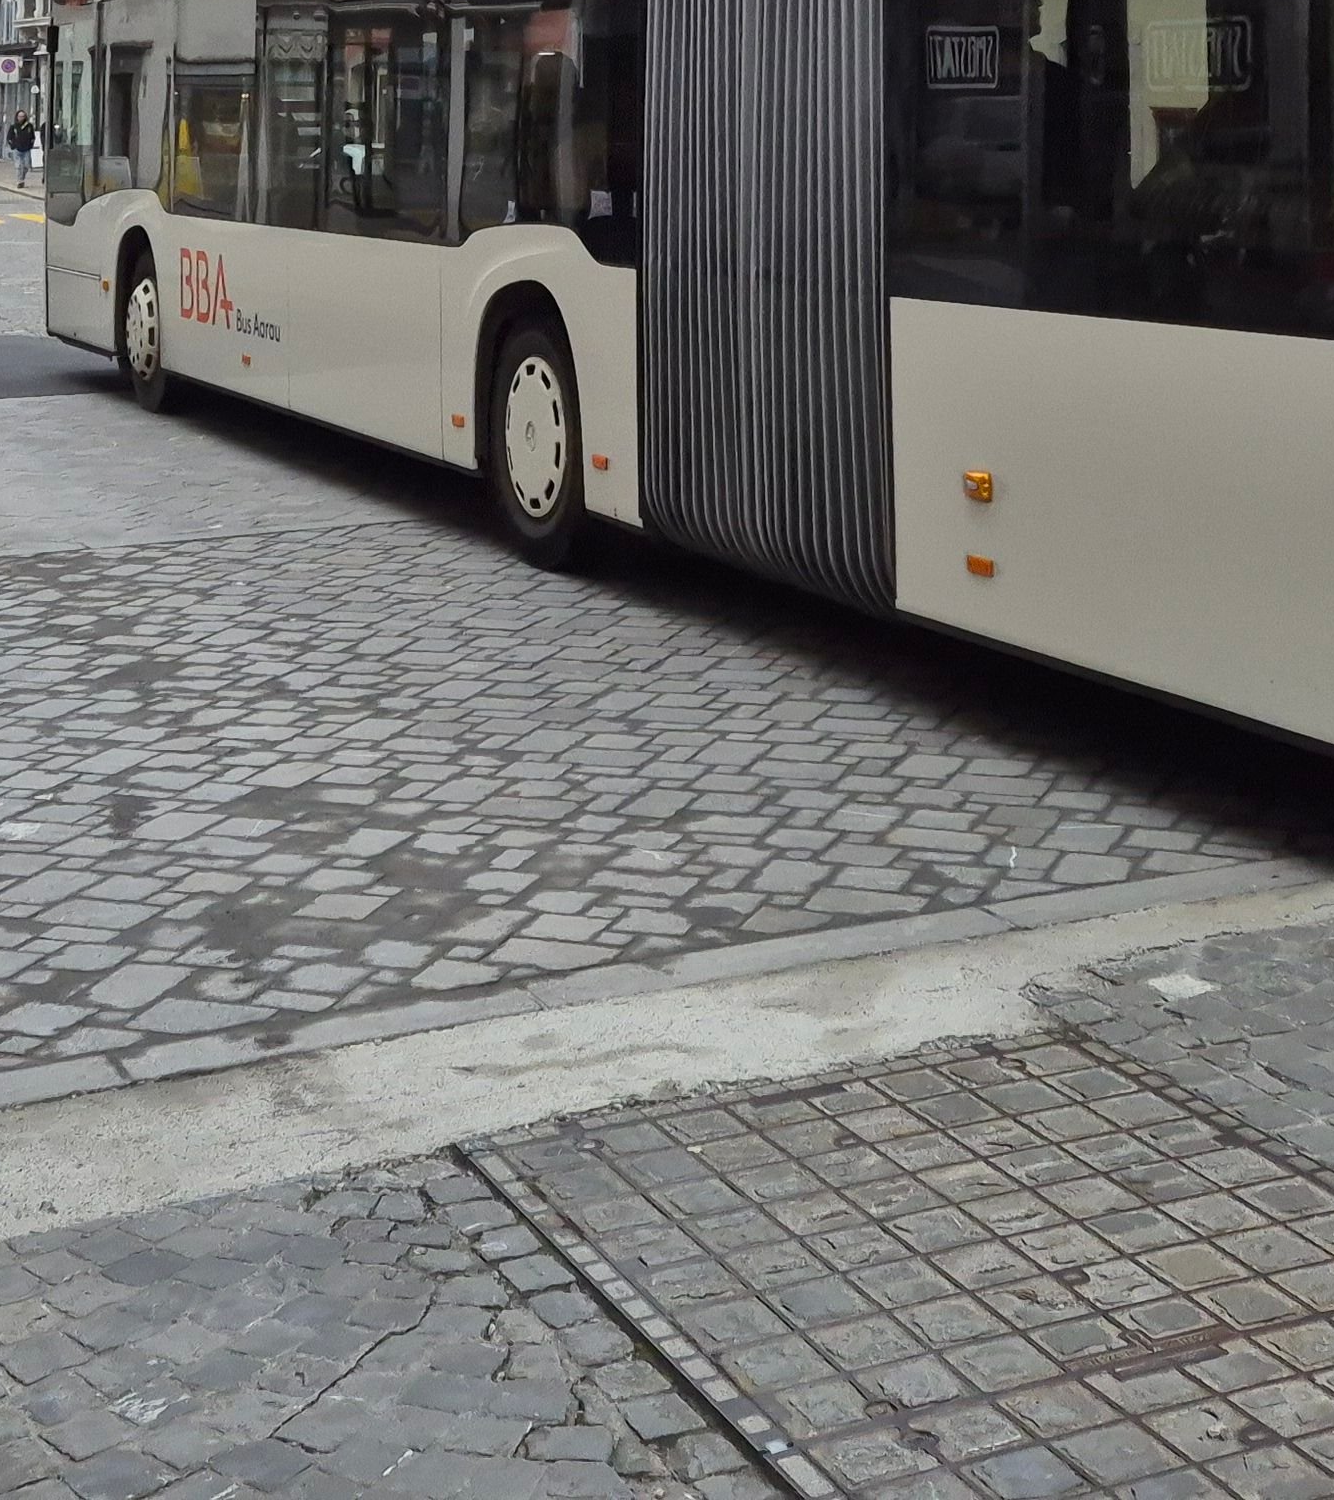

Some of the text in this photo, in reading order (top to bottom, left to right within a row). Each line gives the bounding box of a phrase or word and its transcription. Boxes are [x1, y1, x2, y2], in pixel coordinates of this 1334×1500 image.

[180, 247, 233, 330] BBA
[236, 308, 281, 342] Bus Aarau
